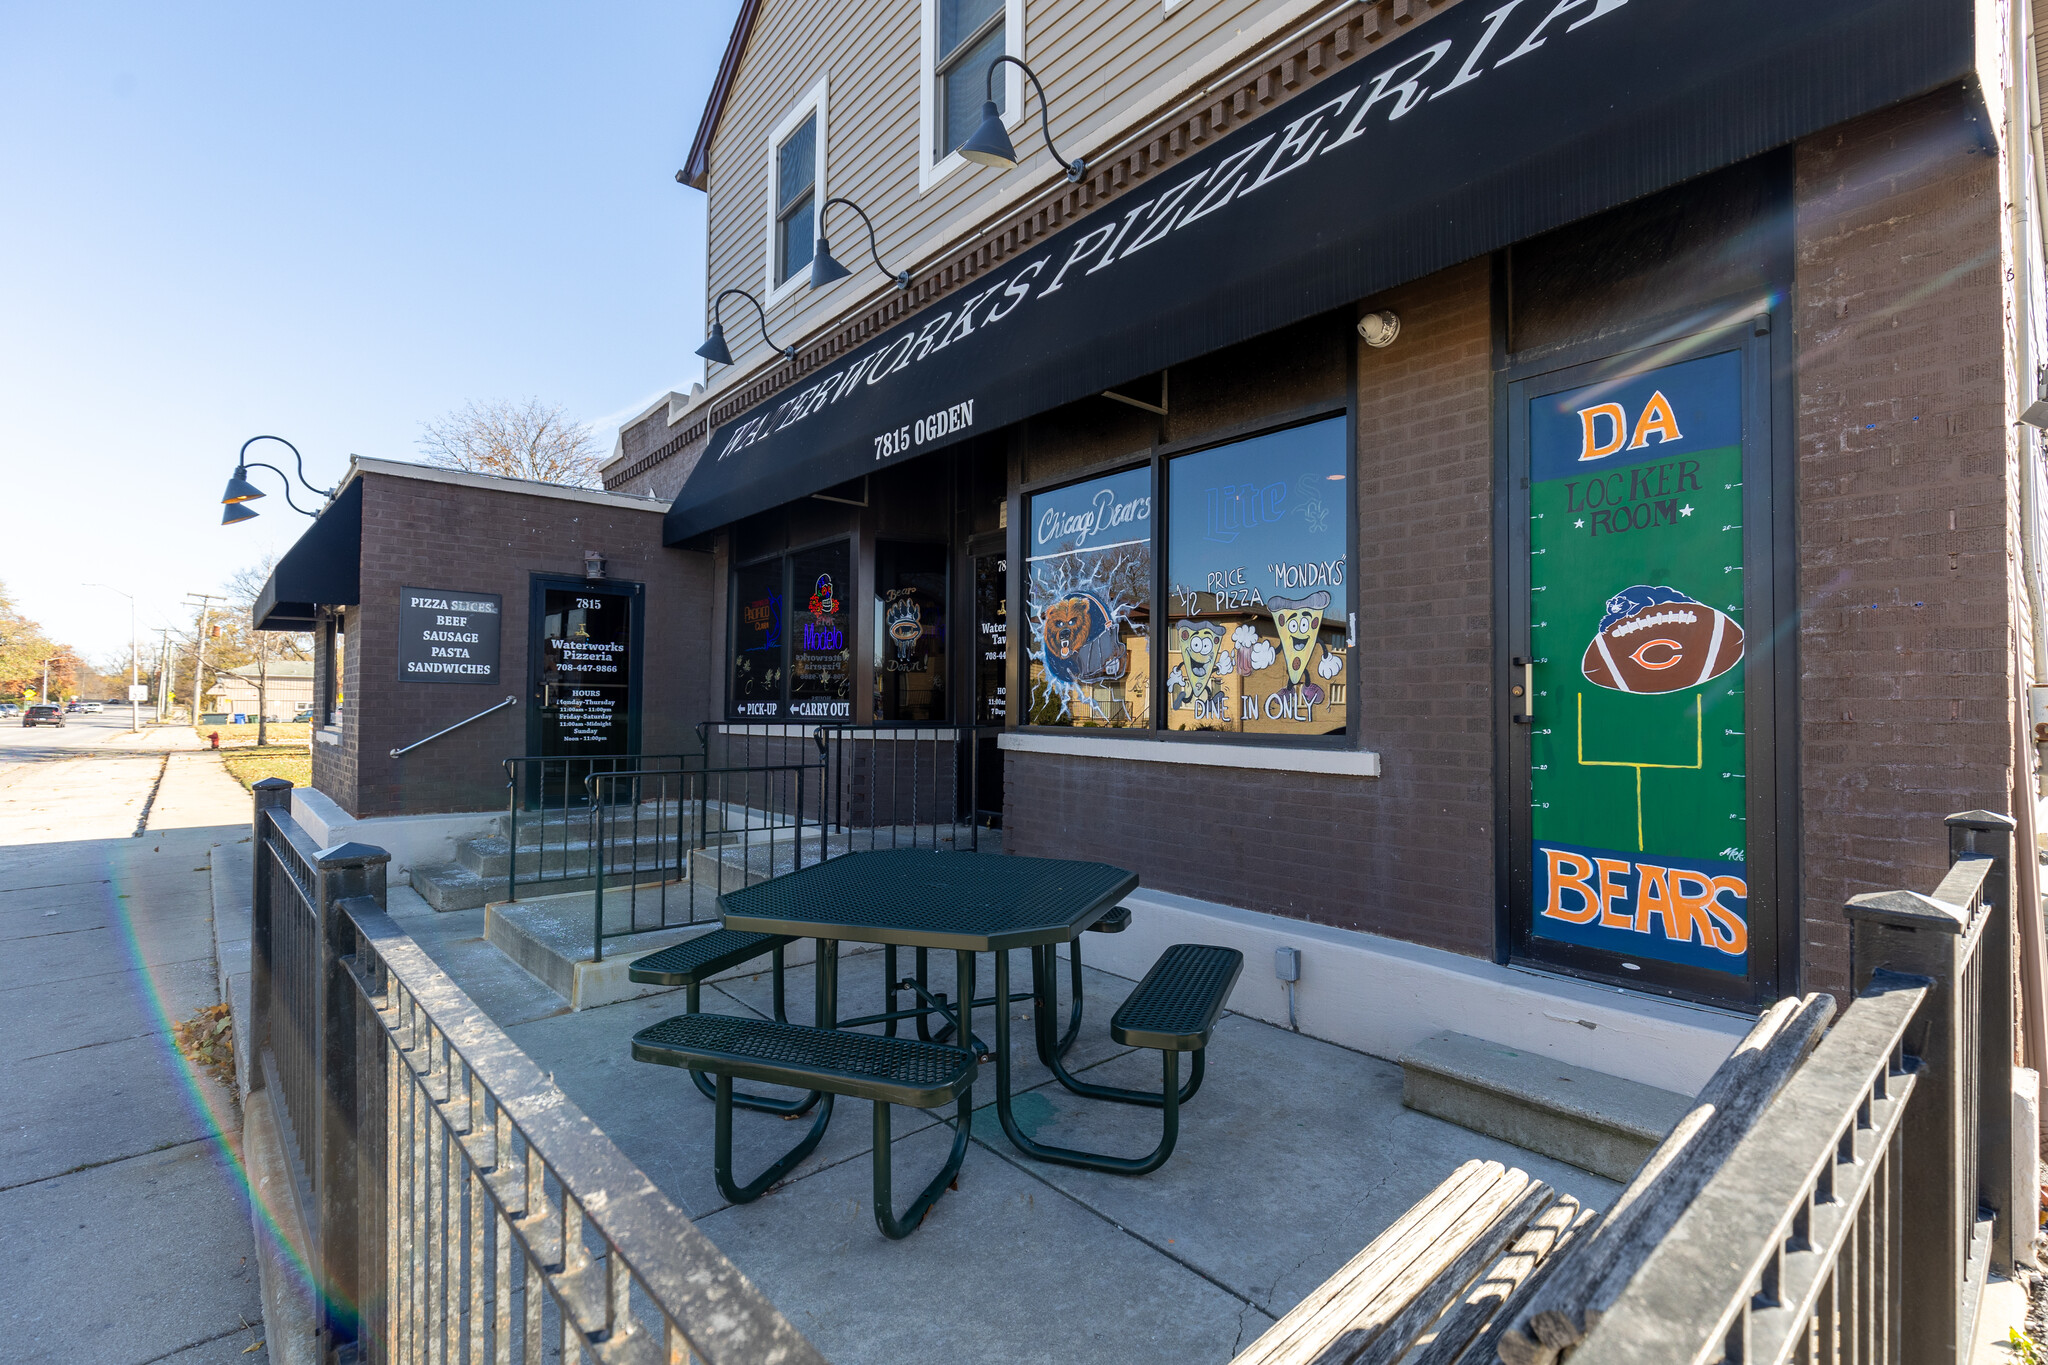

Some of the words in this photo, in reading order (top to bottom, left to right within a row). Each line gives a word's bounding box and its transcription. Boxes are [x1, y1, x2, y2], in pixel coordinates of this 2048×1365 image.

[718, 255, 1052, 461] WATERWORKS
[874, 428, 910, 460] 7815
[915, 399, 974, 445] OGDEN
[1577, 389, 1684, 462] DA
[1565, 460, 1703, 513] LOCKER
[1037, 506, 1094, 546] Chicago
[1089, 489, 1150, 536] Bears
[1202, 481, 1287, 544] Lite
[1590, 498, 1679, 537] ROOM
[1207, 566, 1246, 593] PRICE
[1267, 553, 1347, 588] "MONDAYS"
[411, 597, 448, 610] PIZZA
[451, 600, 493, 613] SLICES
[576, 598, 602, 609] 7815
[1215, 587, 1264, 611] PIZZA
[437, 615, 467, 627] BEEF
[423, 630, 479, 643] SAUSAGE
[551, 640, 624, 652] Waterworks
[804, 623, 843, 651] Modelo
[431, 647, 470, 658] PASTA
[563, 650, 613, 661] Pizzeria
[408, 662, 491, 675] SANDWICHES
[556, 664, 617, 672] 708-447-9866
[747, 703, 777, 715] PICK-UP
[800, 702, 829, 715] CARRY
[830, 702, 849, 715] OUT
[1194, 697, 1232, 722] DINE
[1240, 694, 1259, 721] IN
[1264, 692, 1318, 722] ONLY
[1540, 848, 1747, 955] BEARS
